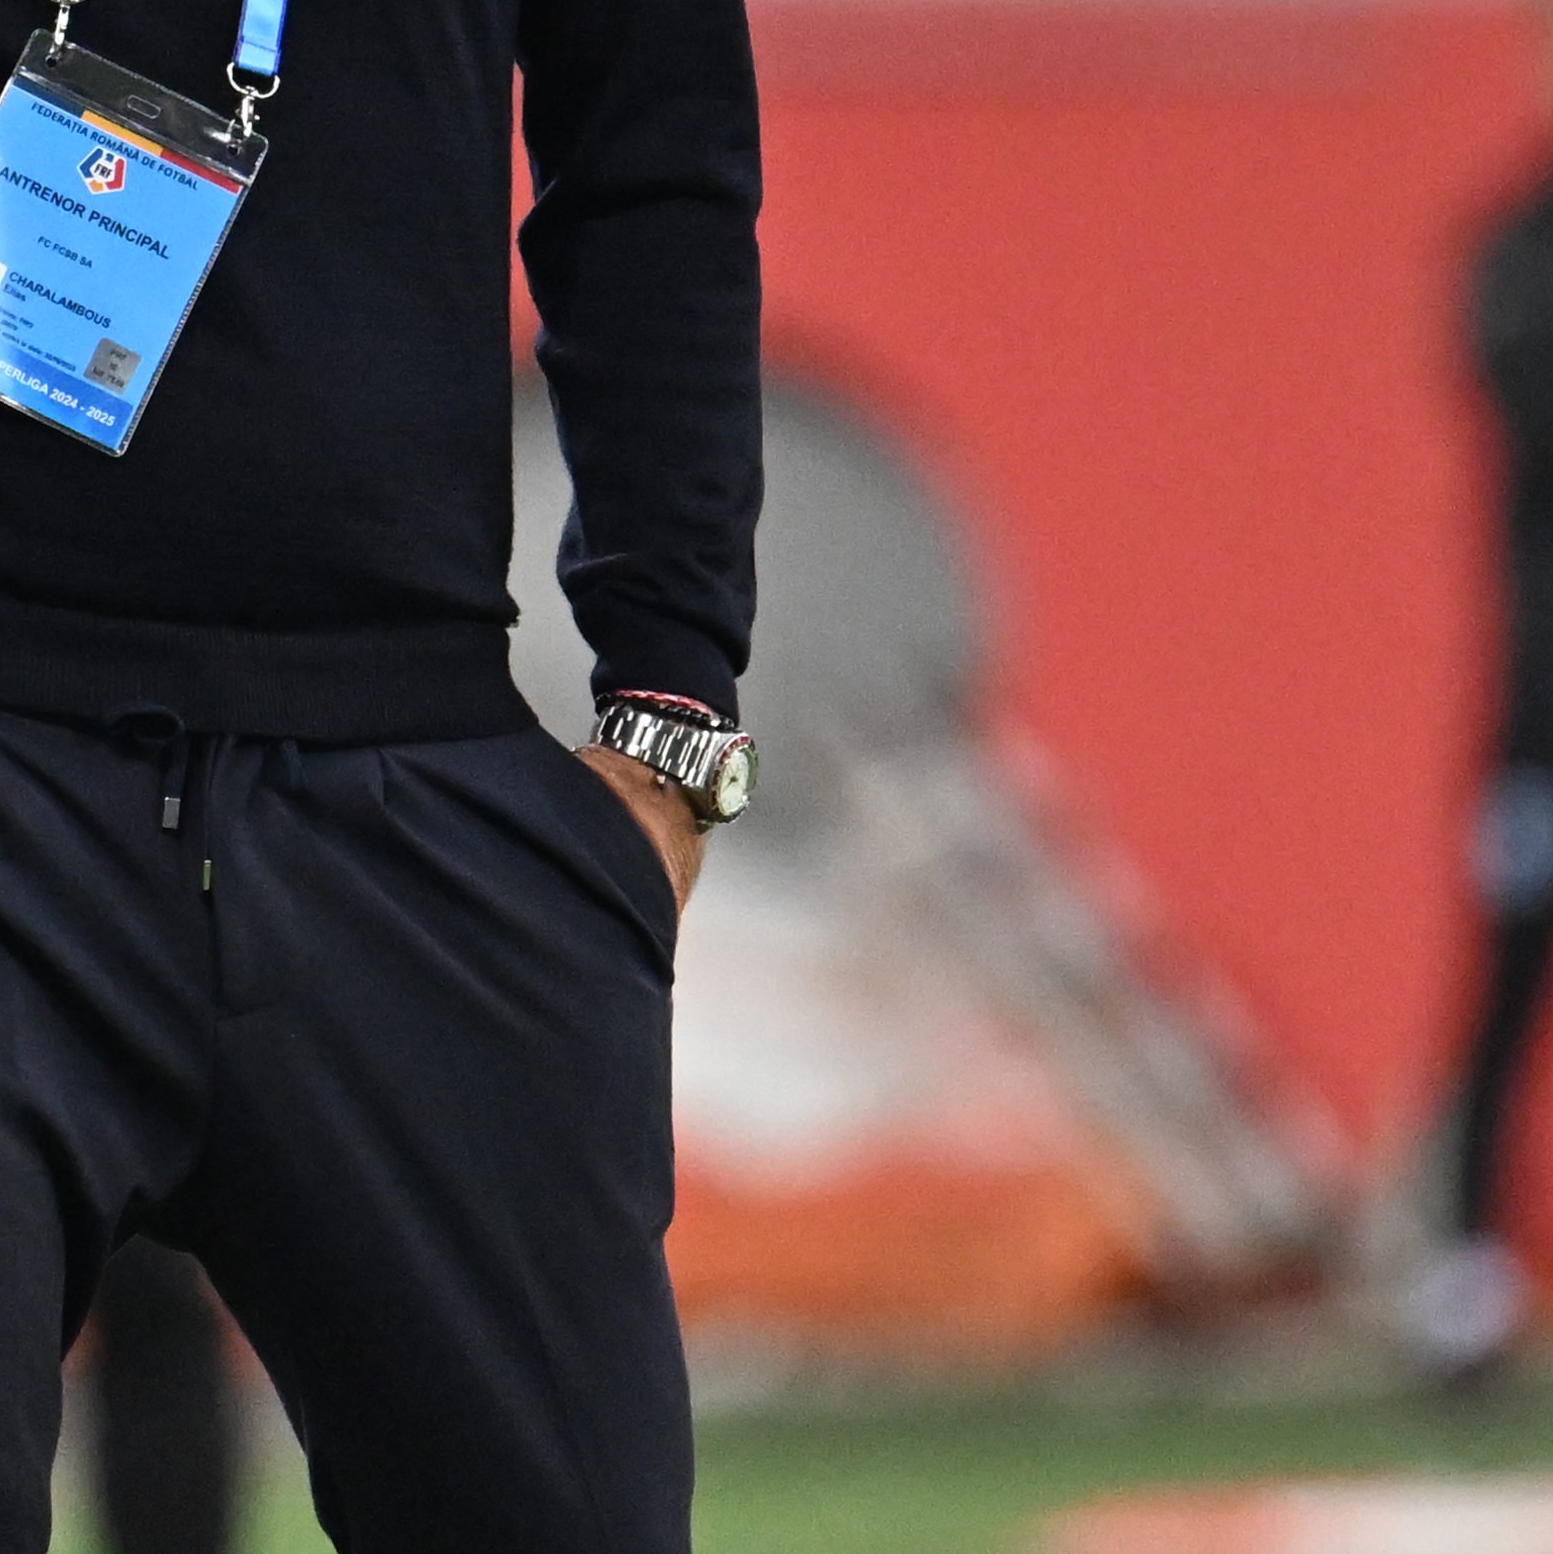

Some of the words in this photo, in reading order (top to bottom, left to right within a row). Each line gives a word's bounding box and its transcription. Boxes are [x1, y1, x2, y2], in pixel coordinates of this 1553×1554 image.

[94, 163, 112, 179] FRF
[142, 156, 157, 169] DE
[158, 164, 198, 190] FOTBAL
[37, 236, 50, 248] FC
[80, 256, 92, 268] SA
[88, 210, 170, 260] PRINCIPAL
[9, 271, 112, 329] CHARALAMBOUS
[49, 388, 79, 409] 2024
[86, 406, 116, 427] 2025
